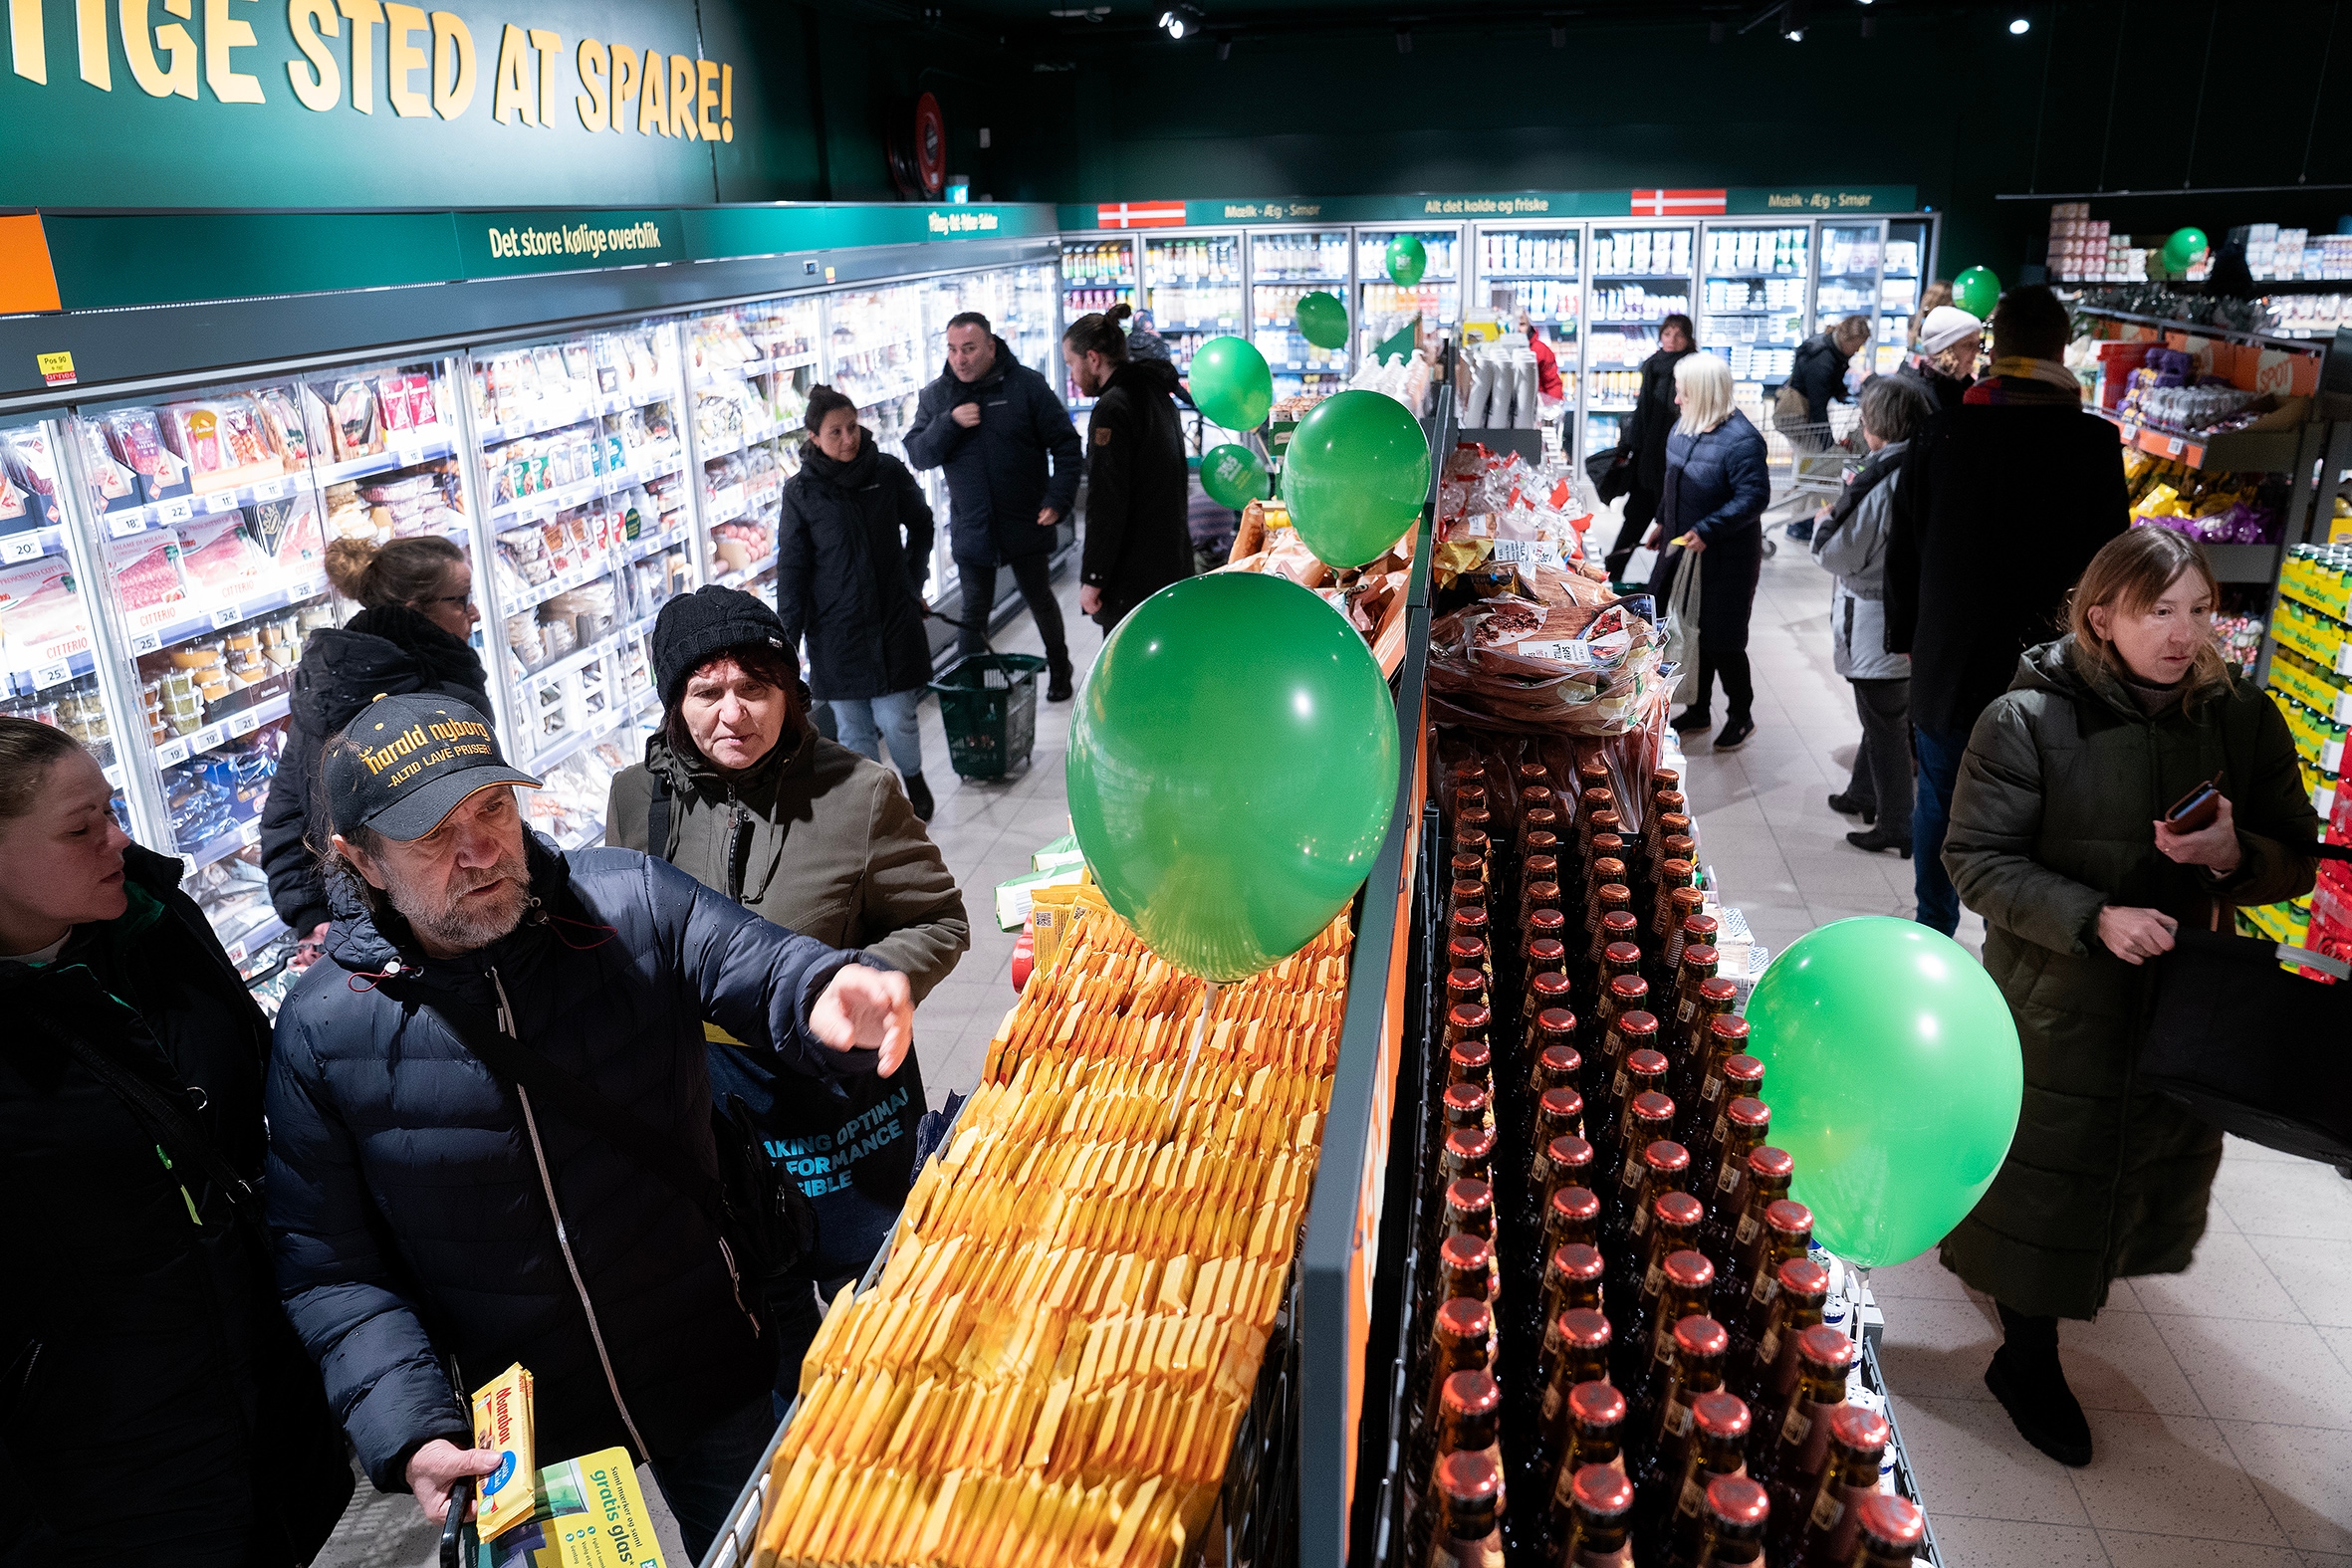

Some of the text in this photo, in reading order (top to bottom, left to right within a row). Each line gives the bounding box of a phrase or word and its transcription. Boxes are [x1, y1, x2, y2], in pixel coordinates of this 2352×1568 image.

[286, 0, 477, 120] STED
[493, 23, 564, 128] AT
[575, 38, 734, 143] SPARE!
[1224, 203, 1320, 219] Mælk Æg Smør
[1424, 198, 1548, 214] Alt det kolde og friske
[1768, 192, 1872, 210] Mælk Æg Smør
[488, 221, 661, 259] Det store kølige overblik
[221, 581, 255, 598] CITTERIO
[139, 607, 176, 627] CITTERIO
[47, 637, 88, 659] CITTERIO
[357, 717, 492, 776] harald nyborg
[387, 742, 493, 788] -ALTID LAVE PRISER!
[785, 1118, 904, 1177] FORMANCE
[496, 1386, 513, 1446] Marabou
[589, 1468, 620, 1522] gratis
[610, 1465, 643, 1548] Saml mærker og saml
